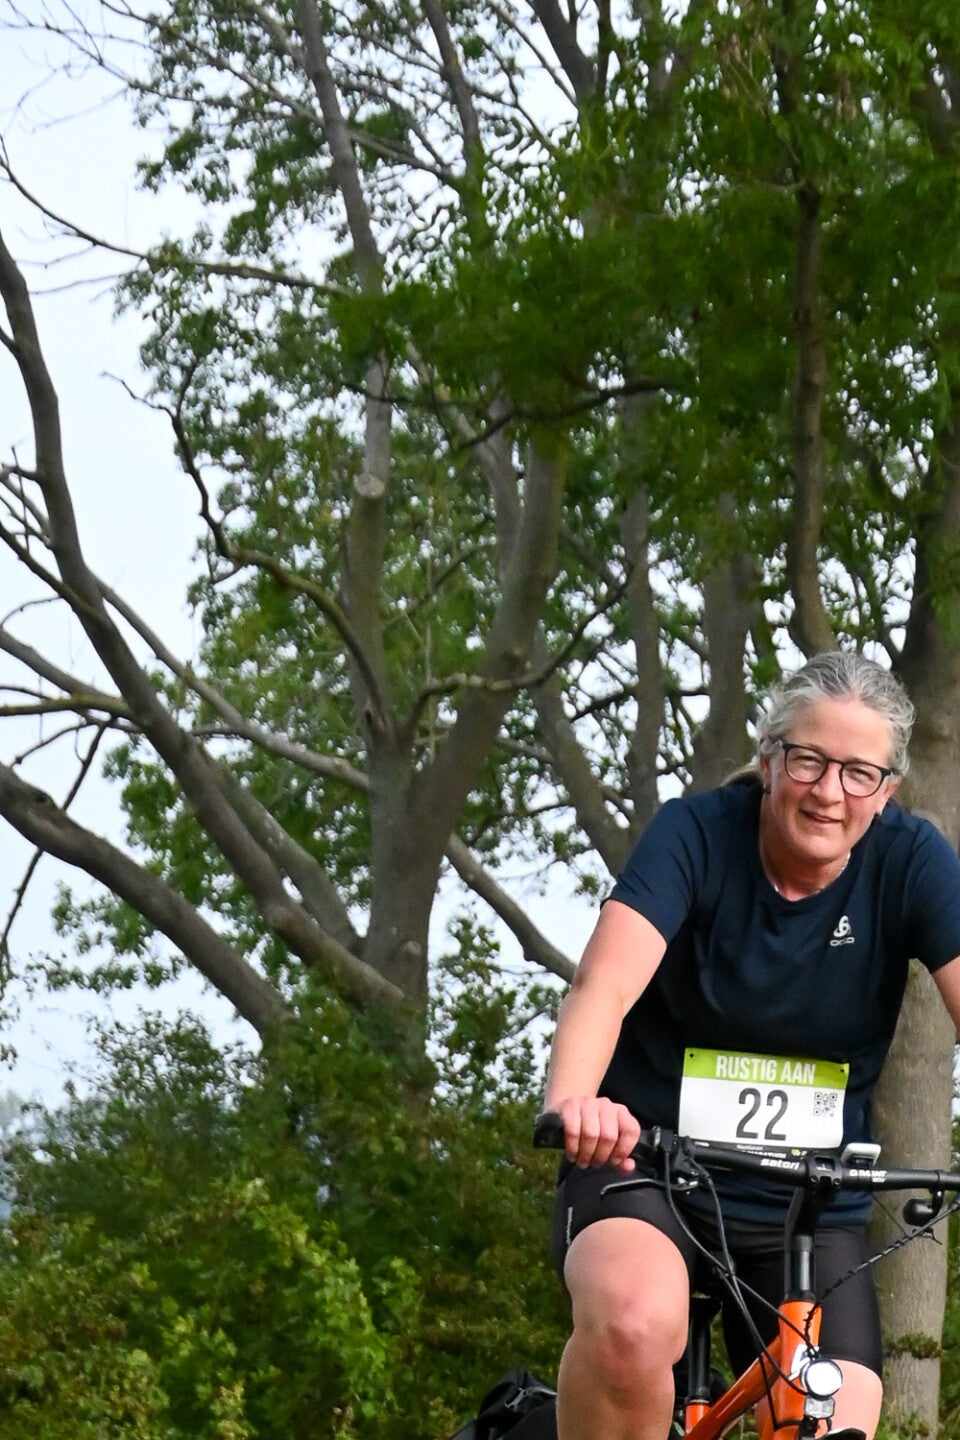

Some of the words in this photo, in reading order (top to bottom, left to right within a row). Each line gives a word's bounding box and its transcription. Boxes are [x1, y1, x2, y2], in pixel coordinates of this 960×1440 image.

[716, 1055, 776, 1080] RUSTIG
[781, 1061, 816, 1084] AAN
[736, 1088, 788, 1140] 22
